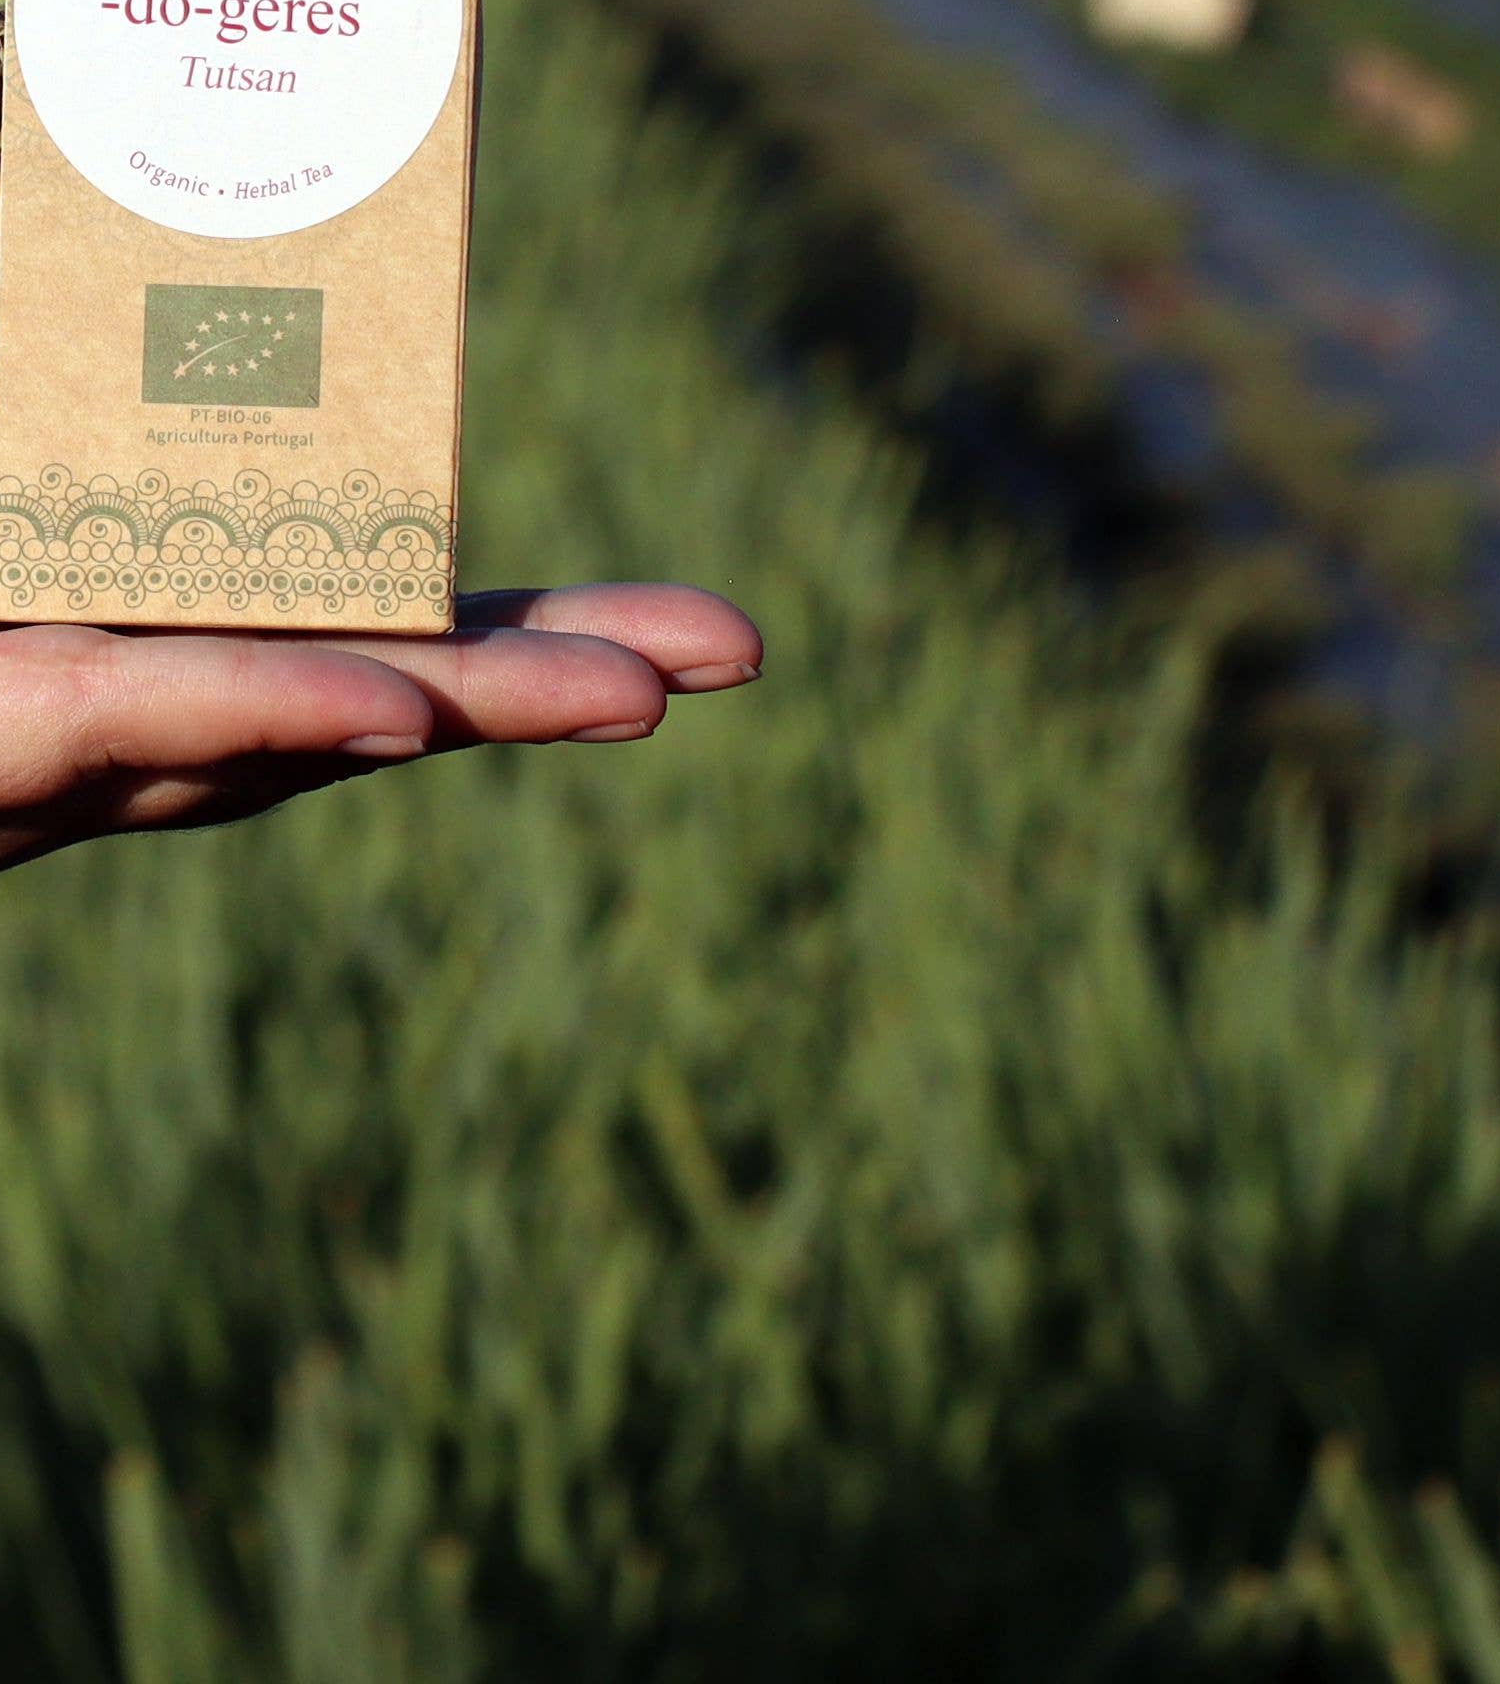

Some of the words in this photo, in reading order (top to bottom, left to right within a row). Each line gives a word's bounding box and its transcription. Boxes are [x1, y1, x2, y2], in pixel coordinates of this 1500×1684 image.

[180, 55, 298, 94] Tutsan
[128, 150, 209, 197] Organic
[234, 173, 297, 200] Herbal
[302, 163, 334, 186] Tea
[190, 409, 272, 425] PT-BIO-06
[145, 427, 238, 446] Agricultura
[243, 431, 314, 450] Portugal
